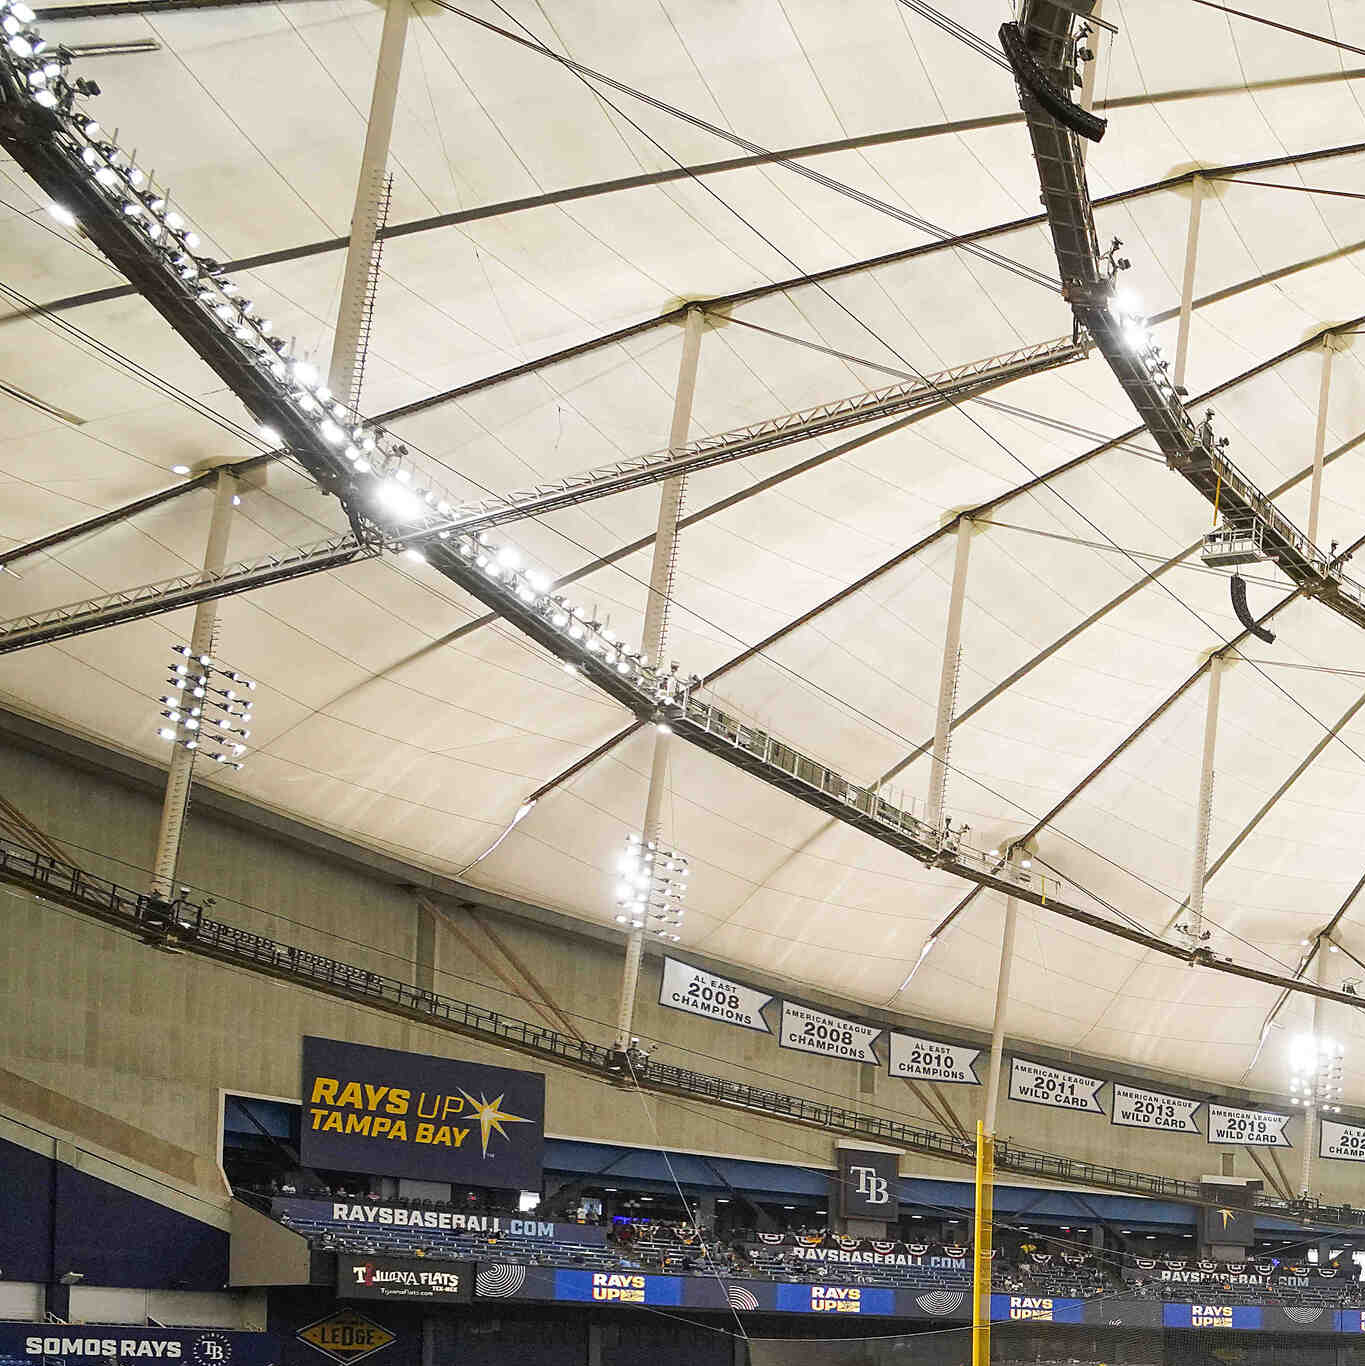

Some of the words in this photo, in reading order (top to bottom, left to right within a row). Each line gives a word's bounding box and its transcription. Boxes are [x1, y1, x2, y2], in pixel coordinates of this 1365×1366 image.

[694, 975, 708, 985] AL
[711, 979, 737, 993] EAST
[687, 981, 740, 1010] 2008
[671, 992, 752, 1025] CHAMPIONS
[784, 1008, 835, 1029] AMERICAN
[837, 1022, 873, 1037] LEAGUE
[803, 1021, 853, 1046] 2008
[789, 1033, 865, 1060] CHAMPIONS
[915, 1043, 925, 1051] AL
[928, 1045, 951, 1055] EAST
[910, 1050, 954, 1069] 2010
[898, 1063, 965, 1081] CHAMPIONS
[1014, 1064, 1059, 1080] AMERICAN
[1062, 1074, 1096, 1088] LEAGUE
[1033, 1077, 1076, 1096] 2011
[311, 1077, 411, 1115] RAYS
[417, 1092, 465, 1121] UP
[1018, 1085, 1052, 1101] WILD
[1054, 1093, 1089, 1108] CARD
[1116, 1089, 1159, 1103] AMERICAN
[1161, 1098, 1193, 1109] LEAGUE
[1134, 1101, 1175, 1118] 2013
[1211, 1109, 1251, 1119] AMERICAN
[1252, 1114, 1283, 1124] LEAGUE
[310, 1108, 408, 1142] TAMPA
[415, 1123, 470, 1147] BAY
[1121, 1110, 1150, 1124] WILD
[1154, 1116, 1186, 1129] CARD
[1227, 1118, 1267, 1133] 2019
[1216, 1129, 1244, 1141] WILD
[1247, 1132, 1277, 1144] CARD
[1343, 1129, 1354, 1137] AL
[850, 1166, 889, 1205] TB
[420, 1272, 459, 1287] FLATS
[592, 1273, 646, 1288] RAYS
[592, 1288, 622, 1302] UP
[811, 1286, 861, 1300] RAYS
[811, 1299, 840, 1312] UP
[1010, 1297, 1053, 1310] RAYS
[1192, 1305, 1233, 1317] RAYS
[1010, 1309, 1034, 1321] UP
[1192, 1316, 1214, 1327] UP
[320, 1325, 375, 1345] LEDGE
[25, 1336, 117, 1357] SOMOS
[120, 1338, 182, 1358] RAYS
[203, 1341, 223, 1361] TB
